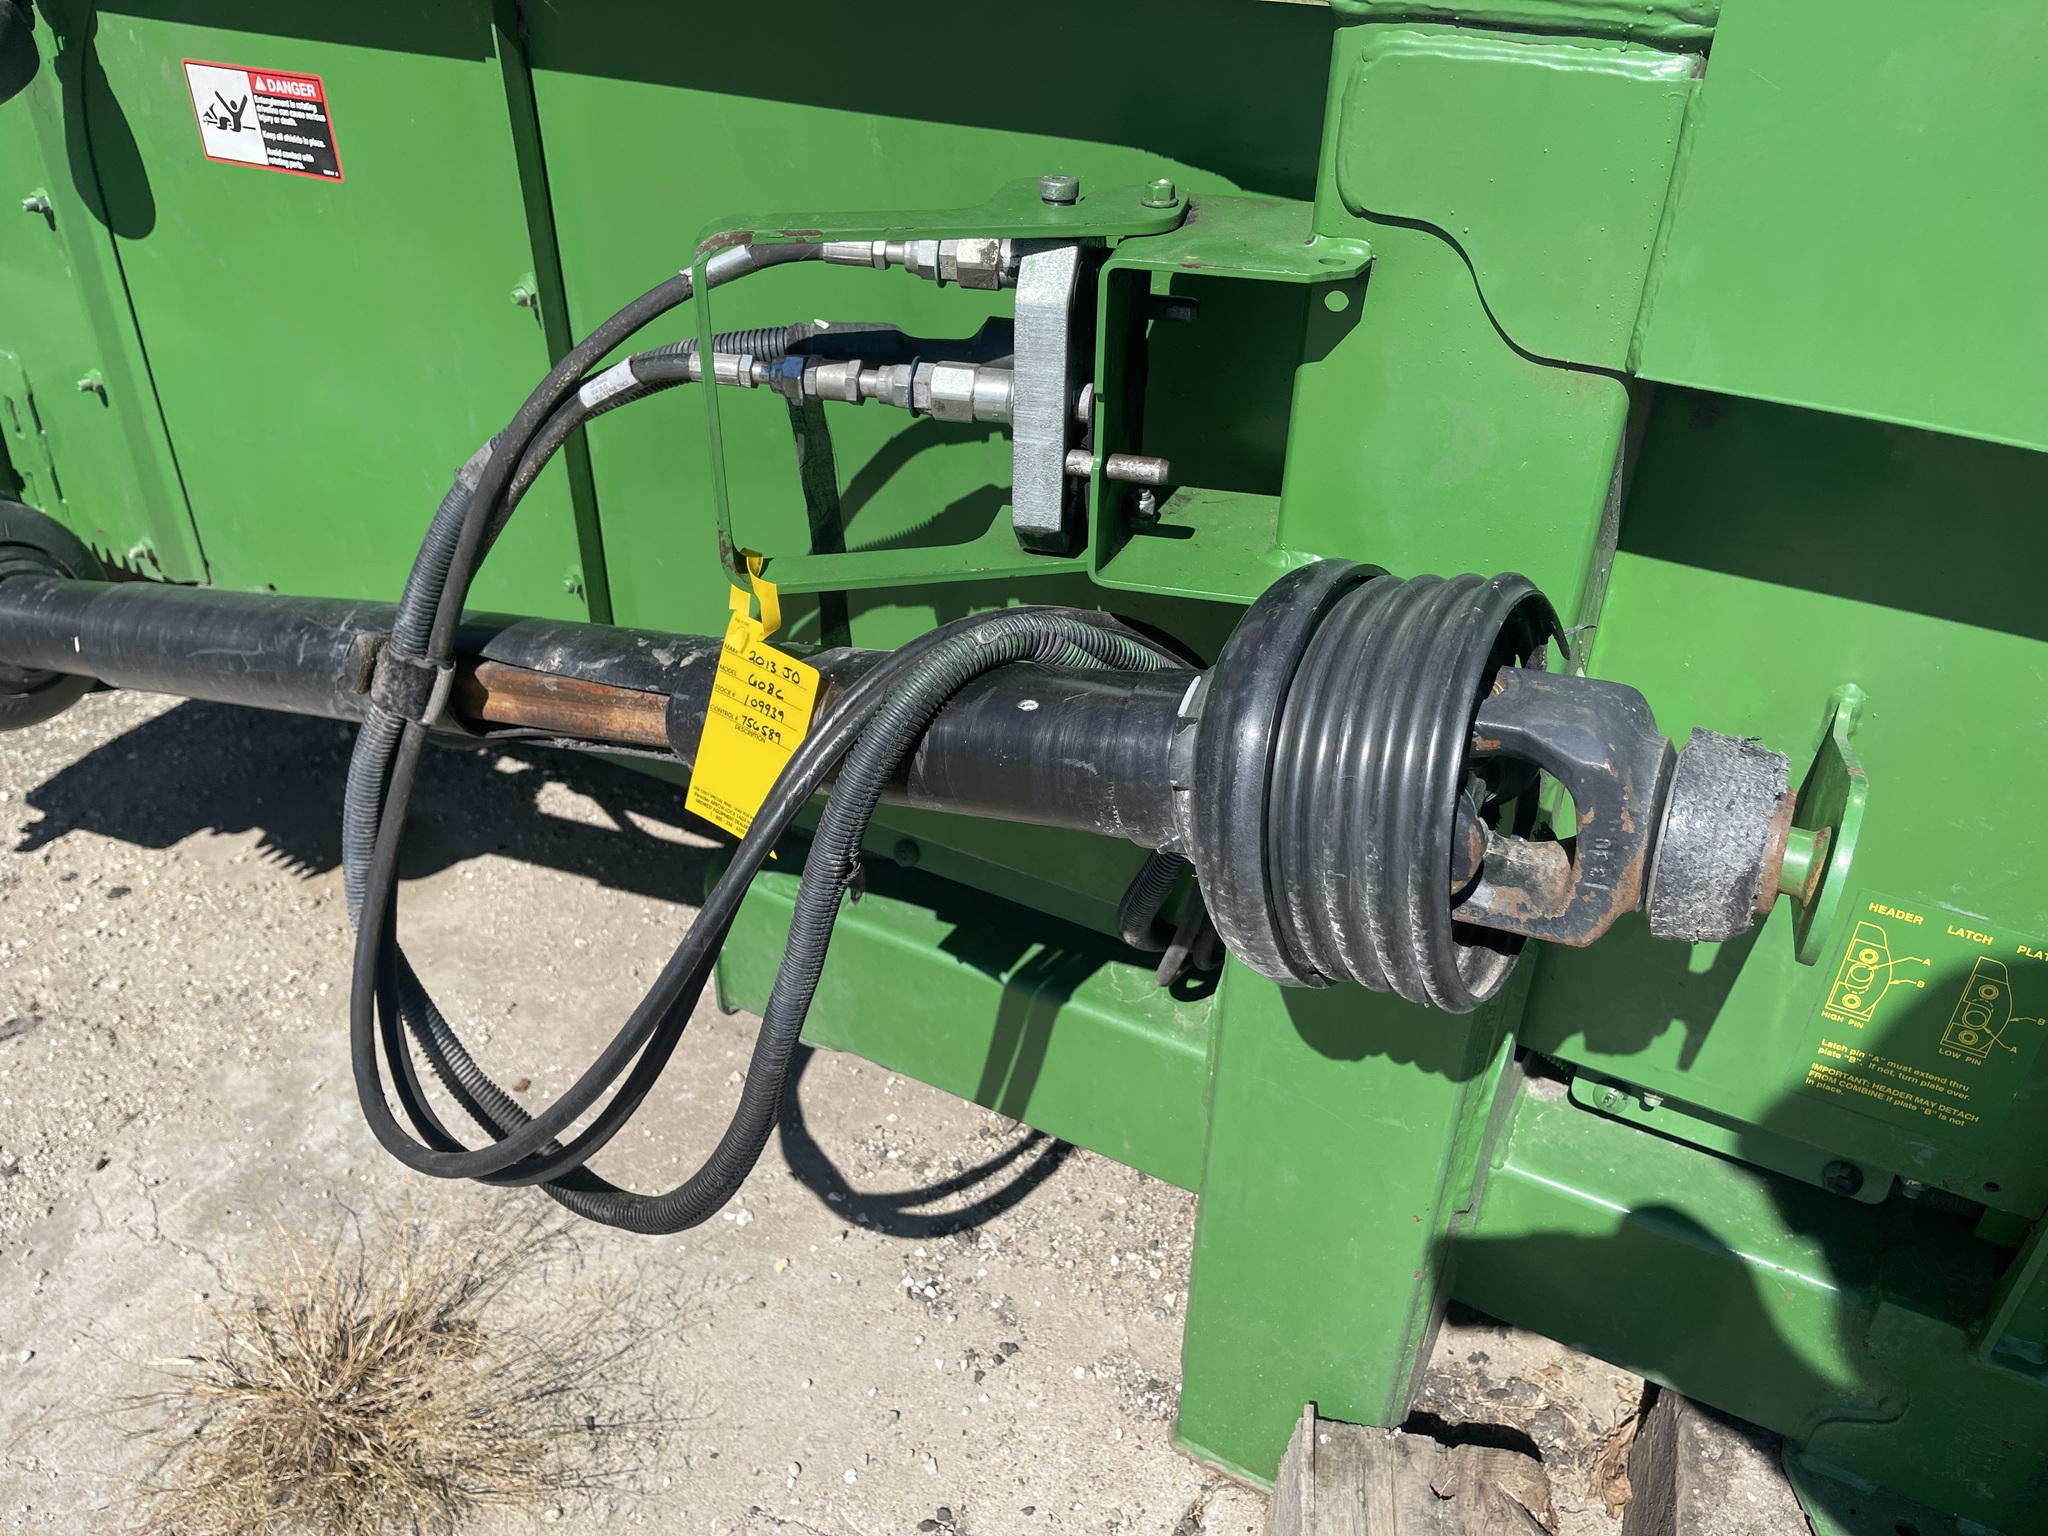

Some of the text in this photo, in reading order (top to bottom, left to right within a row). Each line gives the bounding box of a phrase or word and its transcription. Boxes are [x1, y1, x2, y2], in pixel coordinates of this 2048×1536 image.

[267, 79, 316, 98] DANGER
[720, 664, 736, 676] MODEL
[749, 651, 800, 684] 2013 JD
[715, 684, 731, 696] STOCK
[748, 674, 784, 700] 608C
[710, 704, 733, 719] CONTROL
[744, 695, 784, 723] 109939
[735, 723, 766, 743] DESCRIPTION
[742, 715, 781, 745] 756589
[1868, 902, 1923, 925] HEADER
[1947, 925, 1993, 945] LATCH
[1922, 958, 1930, 966] A
[1916, 980, 1925, 988] B
[1821, 1011, 1864, 1029] HIGH PIN
[2037, 1018, 2046, 1026] B
[1821, 1038, 1848, 1053] Latch
[1849, 1049, 1865, 1058] pin
[1887, 1061, 1912, 1073] must
[1914, 1070, 1948, 1084] extend
[1949, 1080, 1969, 1091] thru
[1939, 1048, 1981, 1066] LOW PIN
[1817, 1047, 1842, 1059] plate
[1898, 1072, 1918, 1083] turn
[1920, 1081, 1945, 1092] plate
[1947, 1089, 1970, 1101] over.
[1806, 1077, 1843, 1095] in place.
[1811, 1063, 1979, 1122] IMPORTANT: HEADER MAY DETACH
[1808, 1070, 1837, 1084] FROM
[1839, 1080, 1884, 1100] COMBINE
[1893, 1100, 1917, 1110] plate
[1949, 1117, 1965, 1126] not
